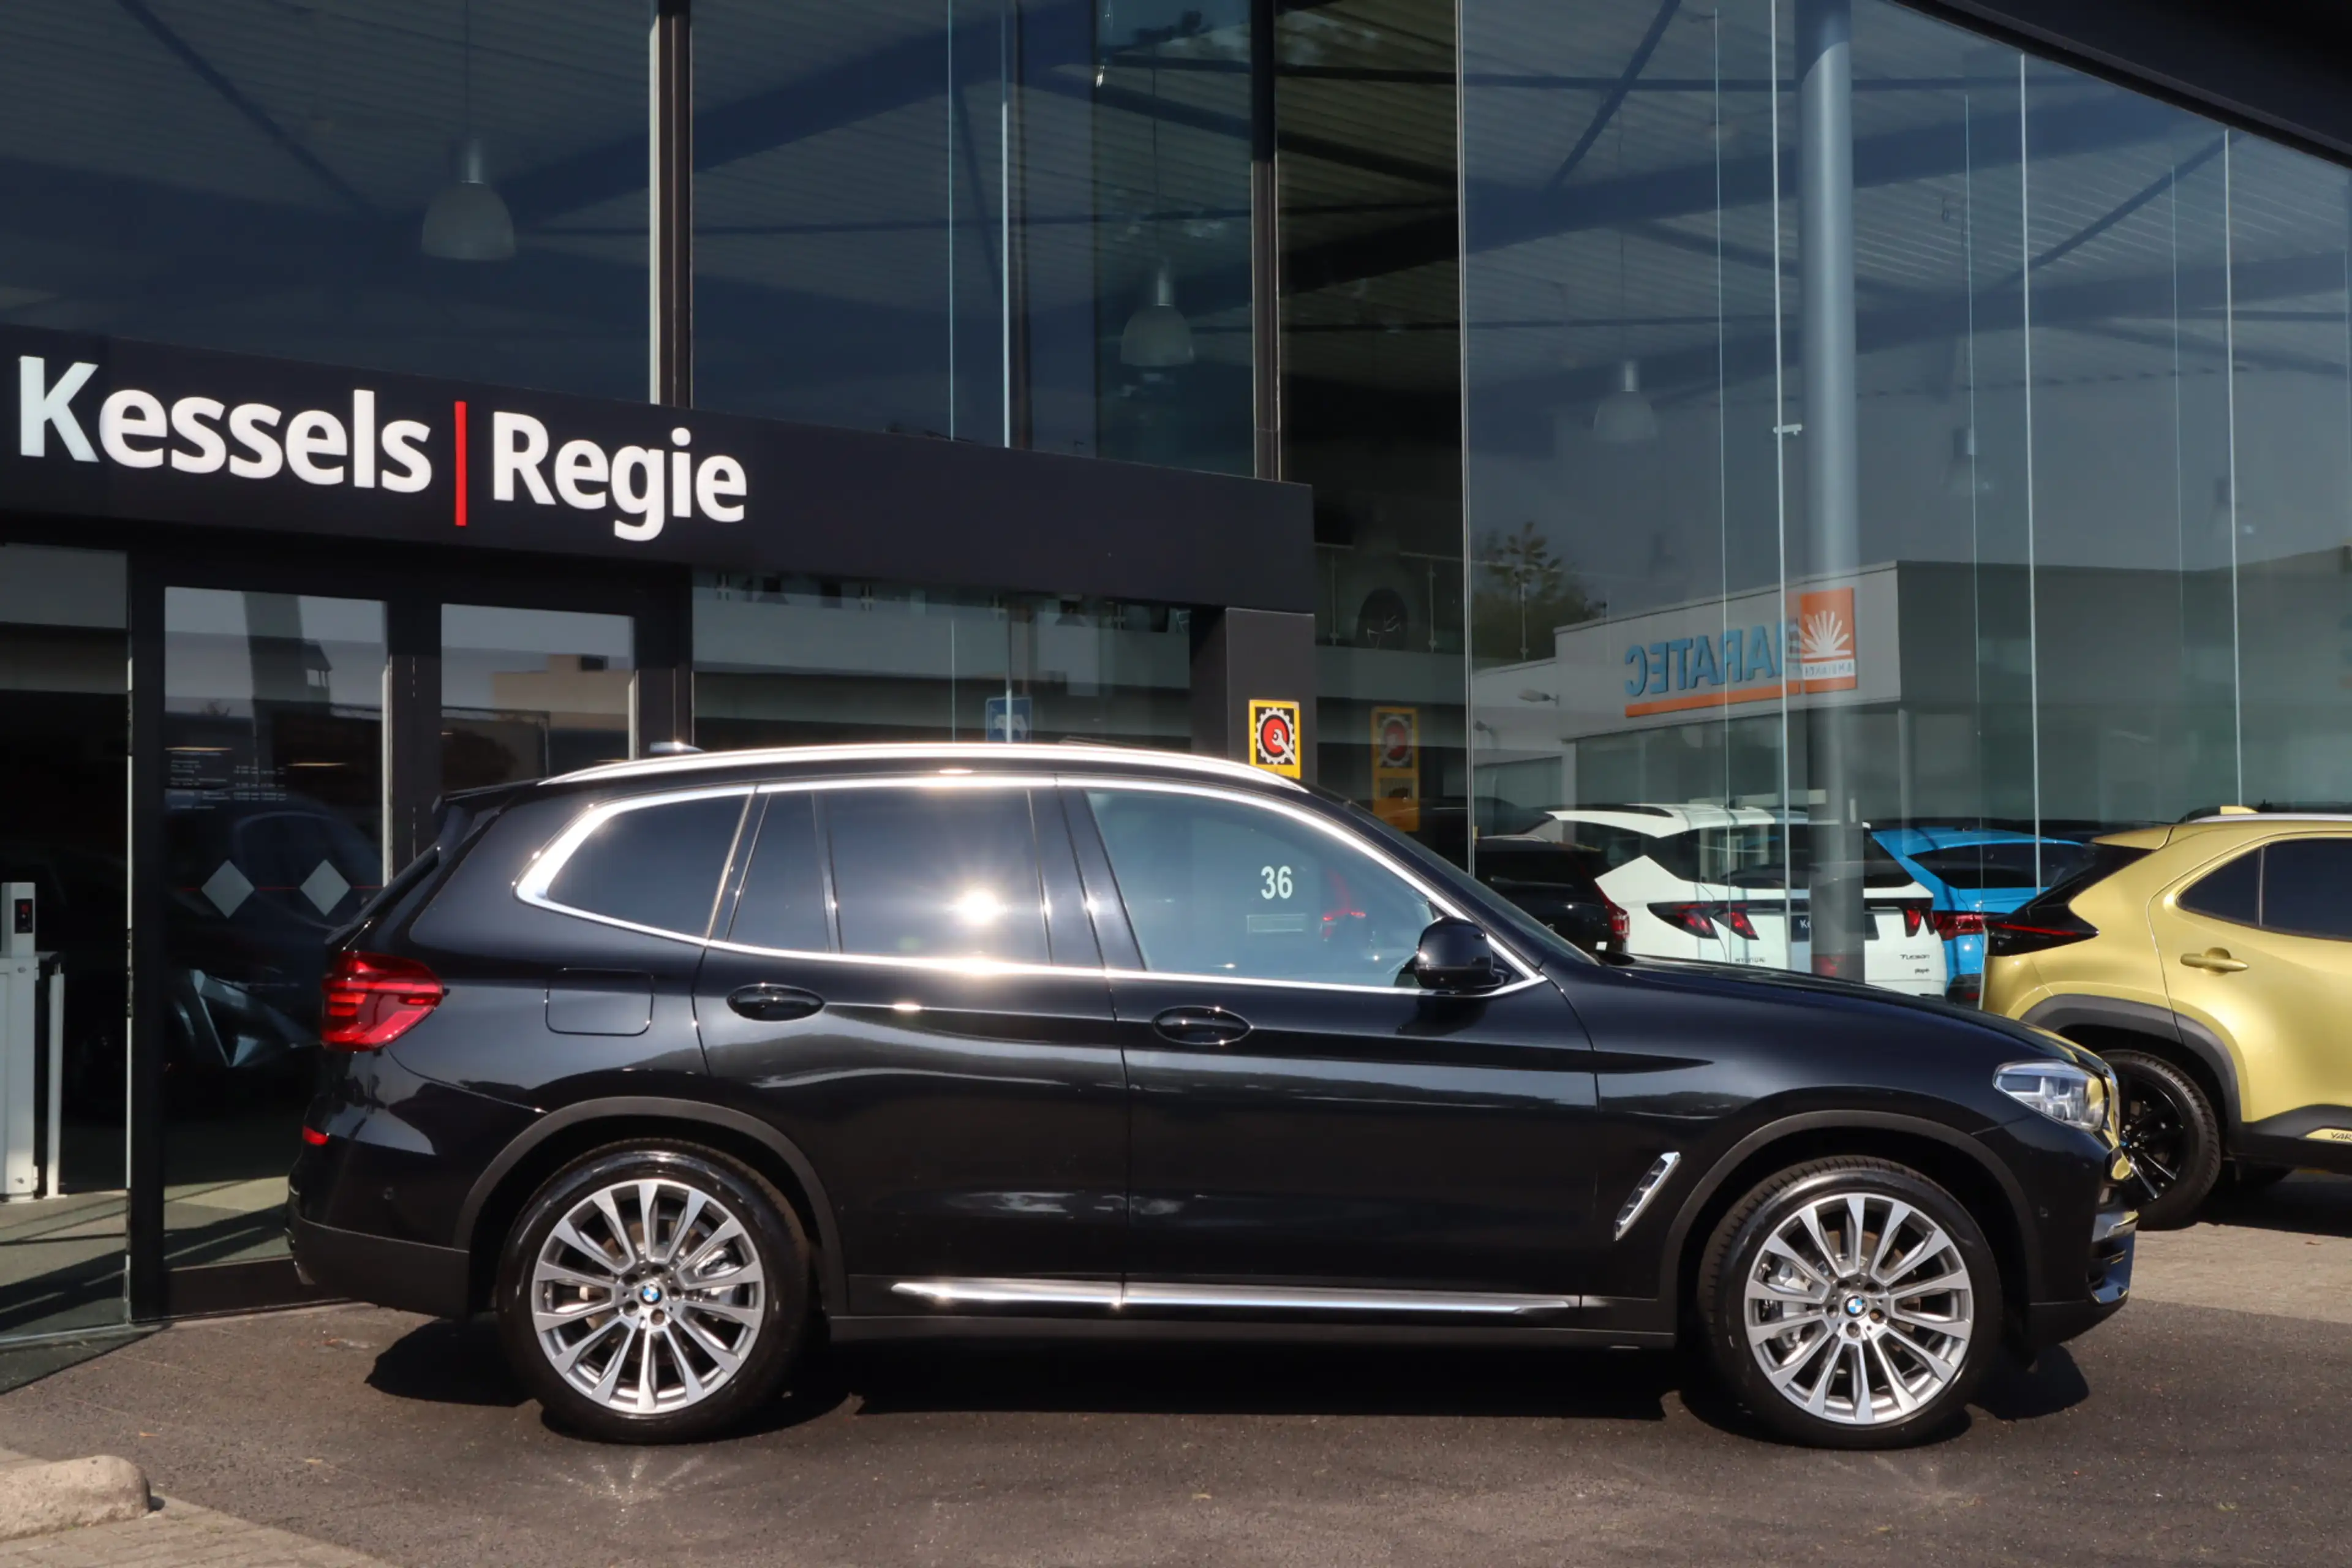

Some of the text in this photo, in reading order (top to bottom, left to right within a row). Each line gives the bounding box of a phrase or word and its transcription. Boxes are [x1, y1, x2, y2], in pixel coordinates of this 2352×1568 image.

[20, 355, 748, 541] Kessels Regie
[1261, 865, 1293, 900] 36
